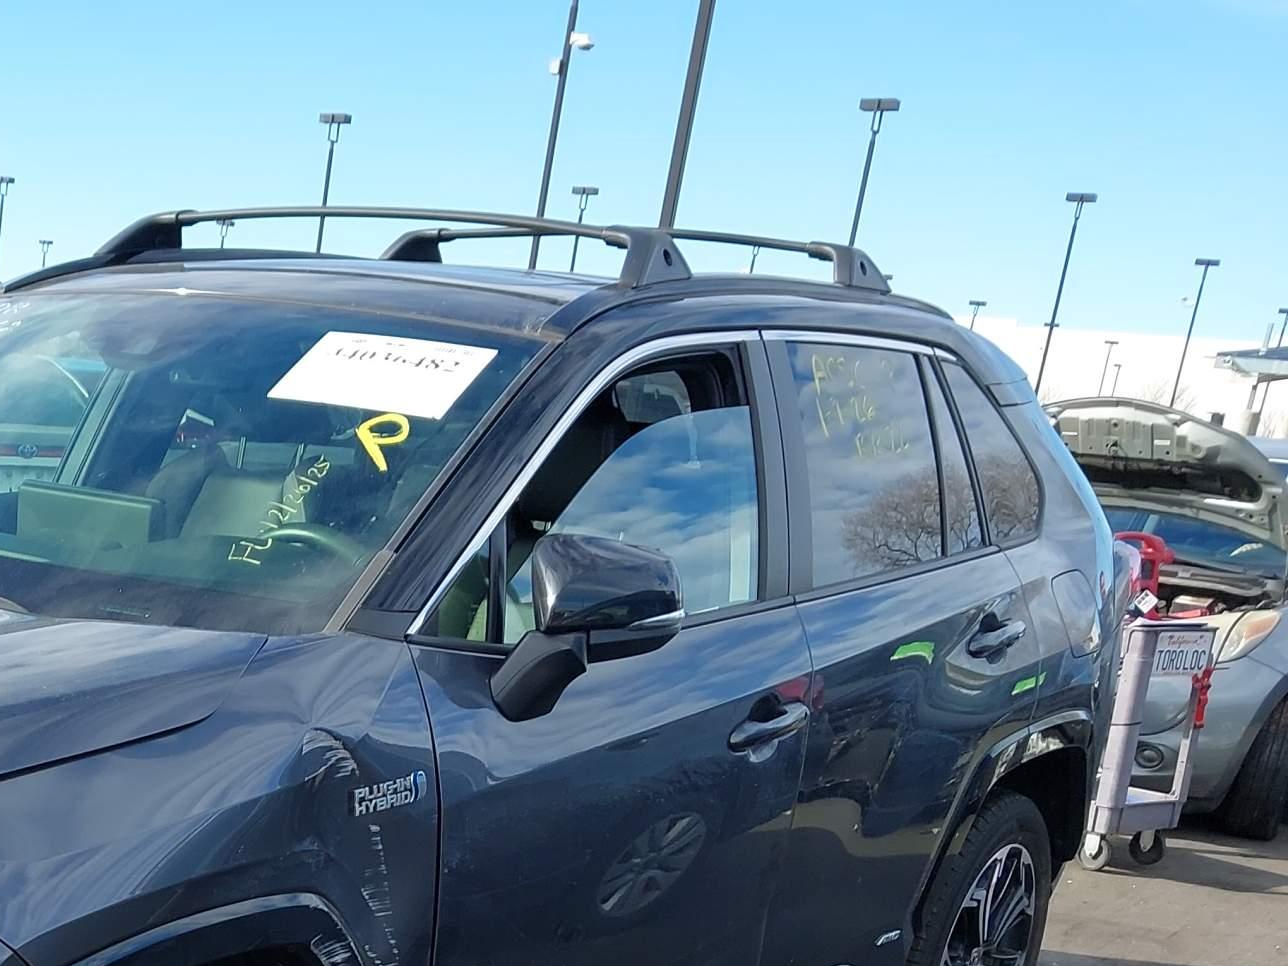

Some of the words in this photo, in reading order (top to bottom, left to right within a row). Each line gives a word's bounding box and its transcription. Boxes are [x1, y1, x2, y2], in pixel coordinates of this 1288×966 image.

[355, 412, 410, 472] P
[1155, 649, 1206, 672] TOROLOC
[355, 791, 413, 816] HYBRID
